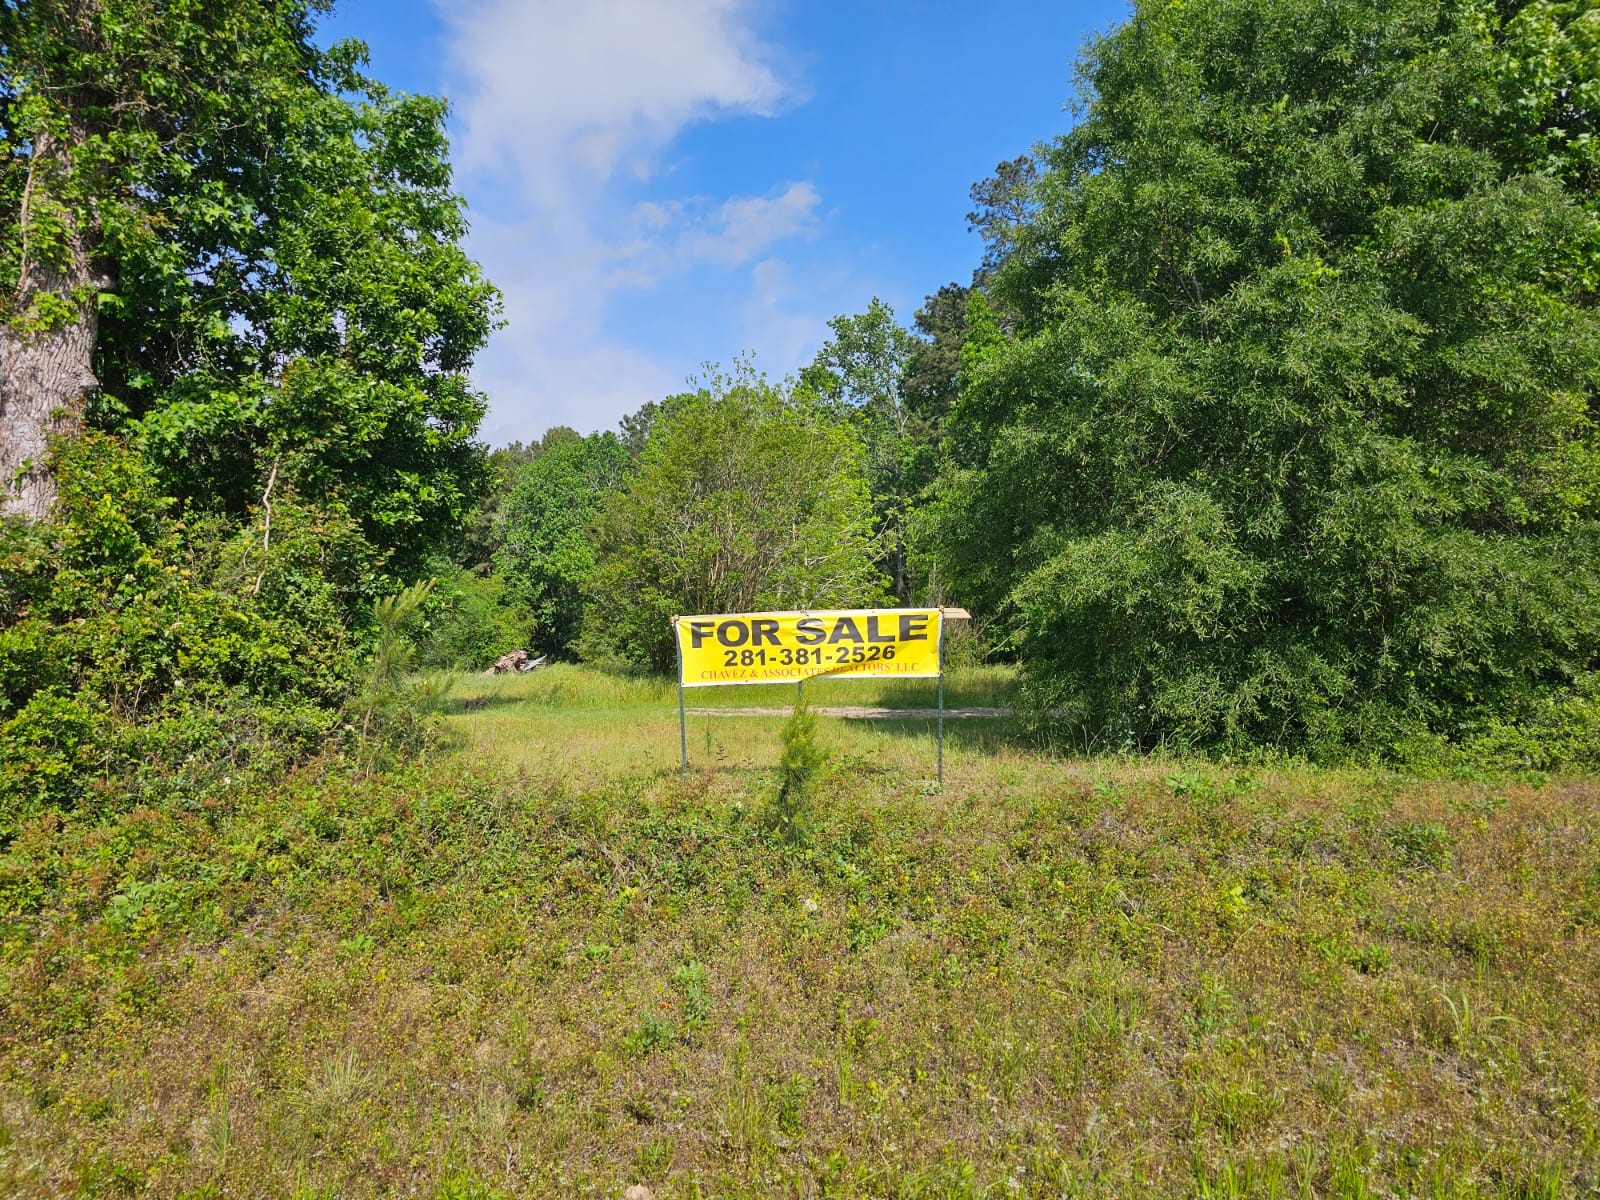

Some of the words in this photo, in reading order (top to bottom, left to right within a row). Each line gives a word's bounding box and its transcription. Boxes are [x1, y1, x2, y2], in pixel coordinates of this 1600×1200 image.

[690, 618, 783, 649] FOR
[795, 614, 929, 645] SALE
[723, 645, 896, 667] 281-381-2526
[701, 670, 748, 680] CHAVEZ
[749, 669, 757, 678] &
[896, 662, 919, 672] LLC
